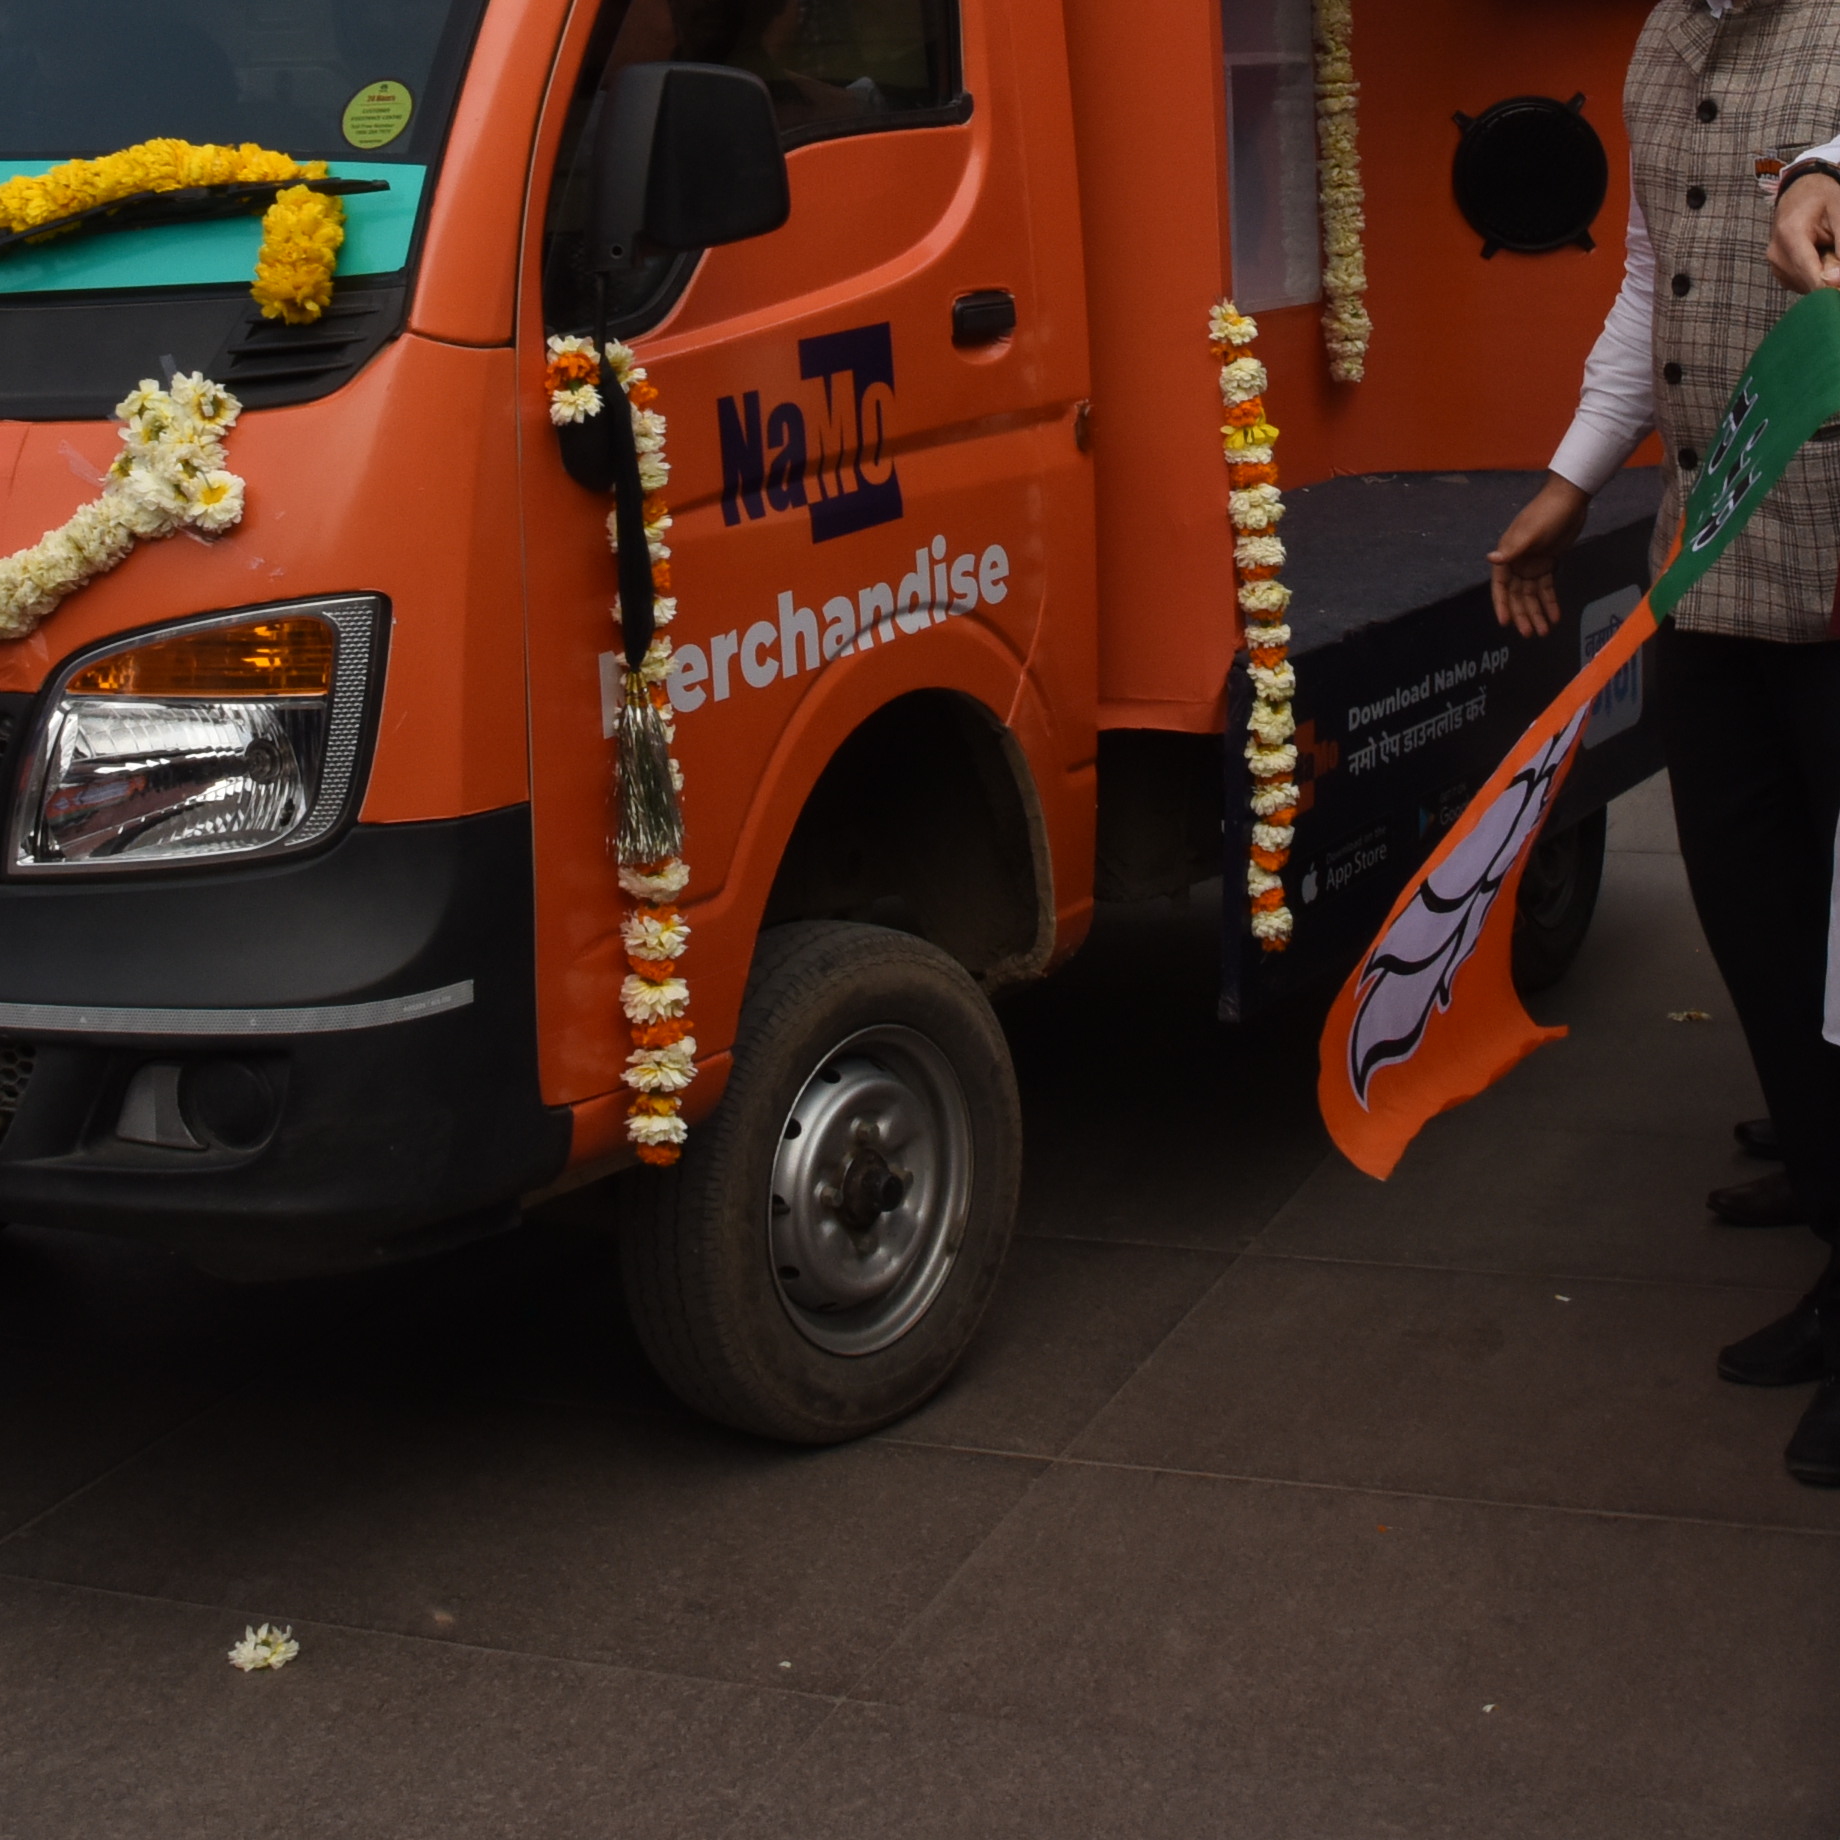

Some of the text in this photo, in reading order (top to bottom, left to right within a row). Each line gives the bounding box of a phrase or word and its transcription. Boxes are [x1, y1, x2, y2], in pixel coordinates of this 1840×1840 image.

[716, 322, 904, 545] NaMo
[1347, 685, 1487, 776] नमो ऐप डाउनलोड करें
[1348, 646, 1509, 732] Download NaMo App
[1325, 843, 1388, 892] App Store
